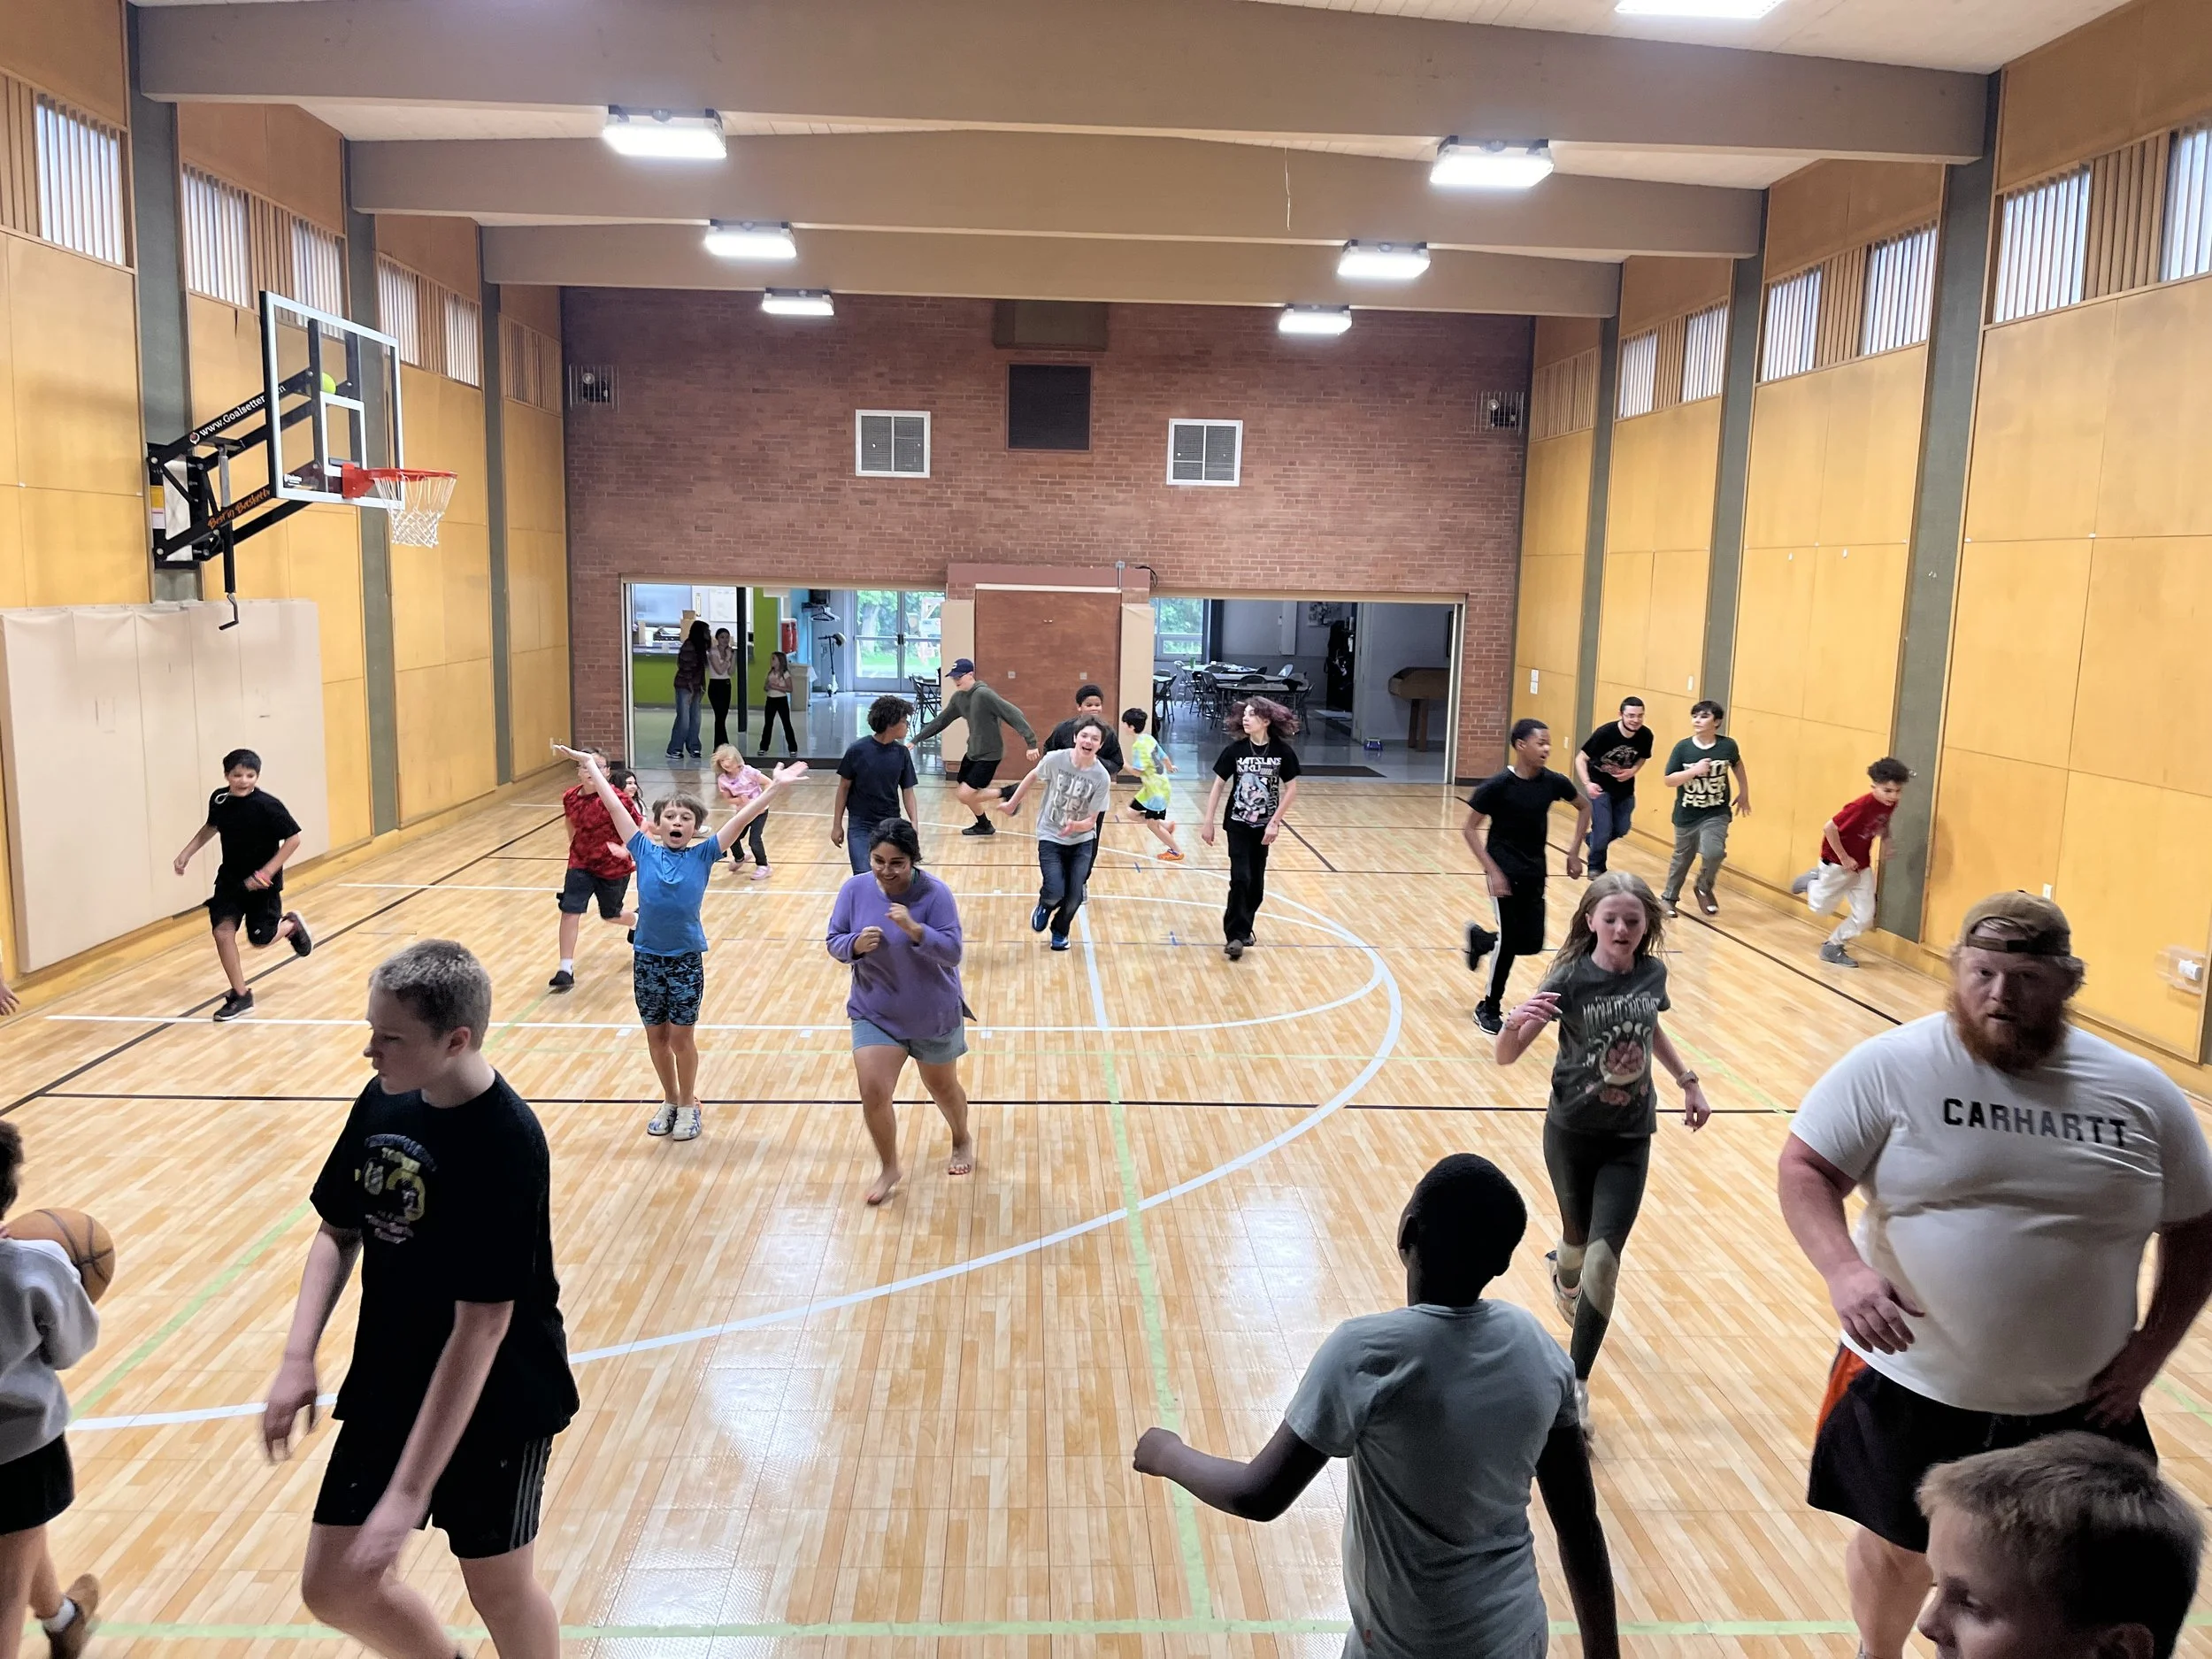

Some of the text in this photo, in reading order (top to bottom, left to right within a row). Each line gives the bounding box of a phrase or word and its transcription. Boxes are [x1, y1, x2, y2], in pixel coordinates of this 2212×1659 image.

[1684, 776, 1726, 794] OVER
[1682, 792, 1724, 808] FEAR
[1943, 1097, 2127, 1147] CARHARTT
